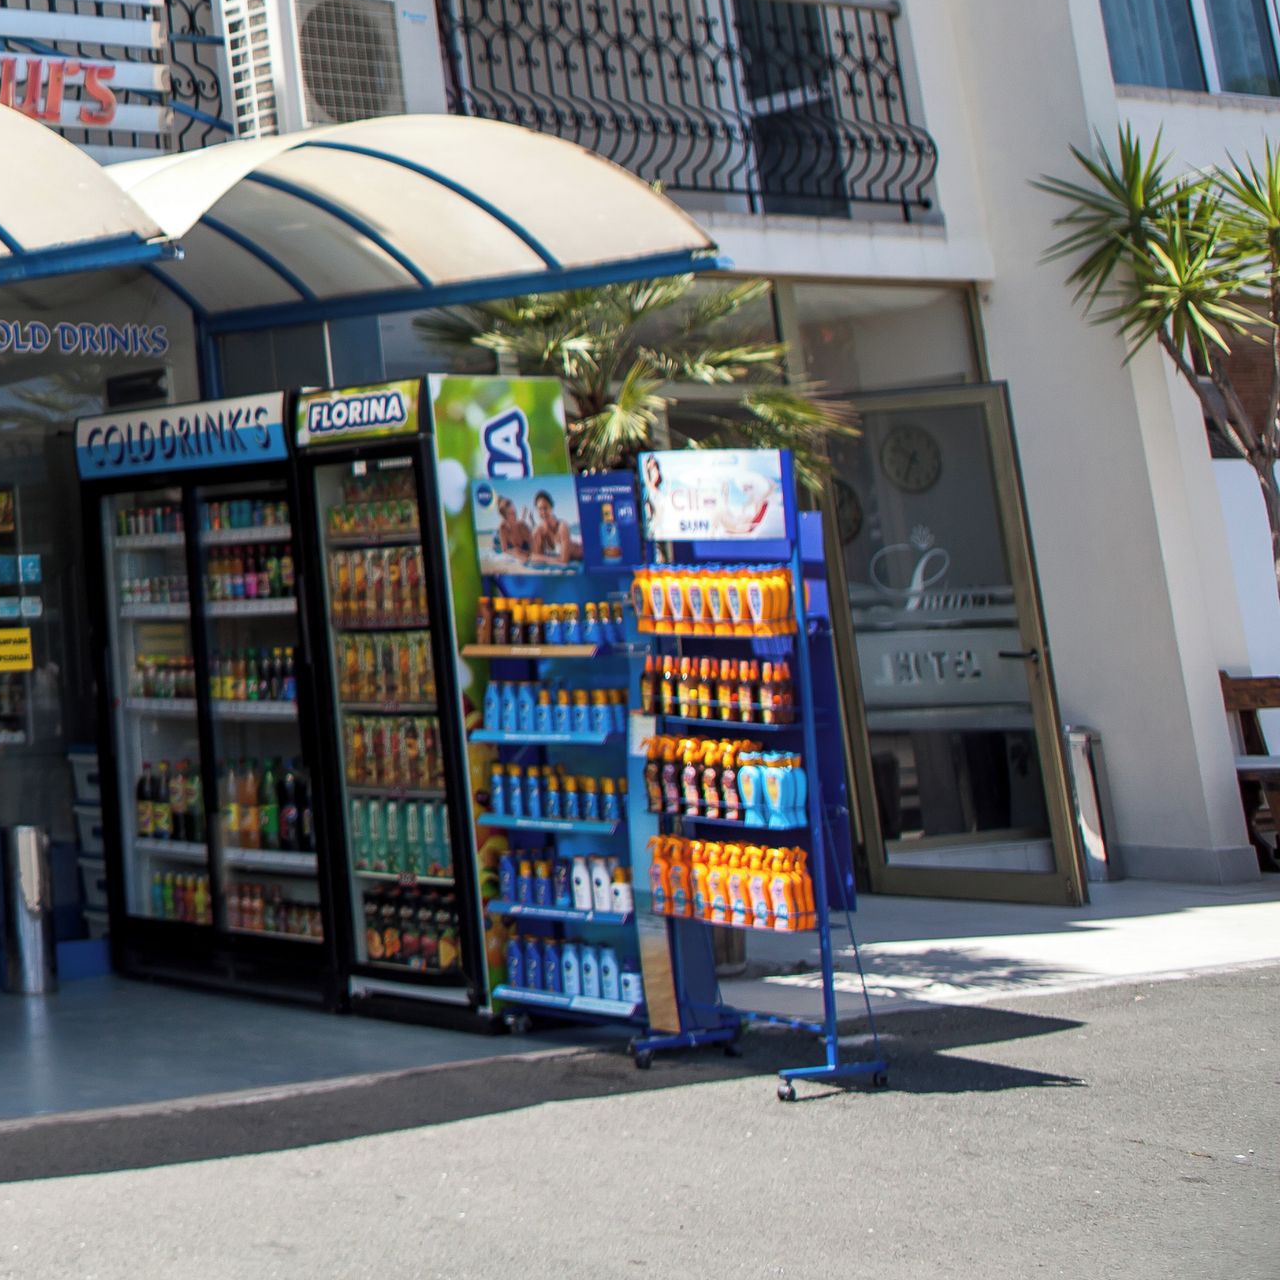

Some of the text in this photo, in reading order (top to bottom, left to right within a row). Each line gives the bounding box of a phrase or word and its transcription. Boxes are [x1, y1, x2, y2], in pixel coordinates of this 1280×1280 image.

[54, 322, 169, 357] DRINKS
[307, 389, 407, 435] FLORINA
[87, 405, 272, 469] COLD DRINK'S
